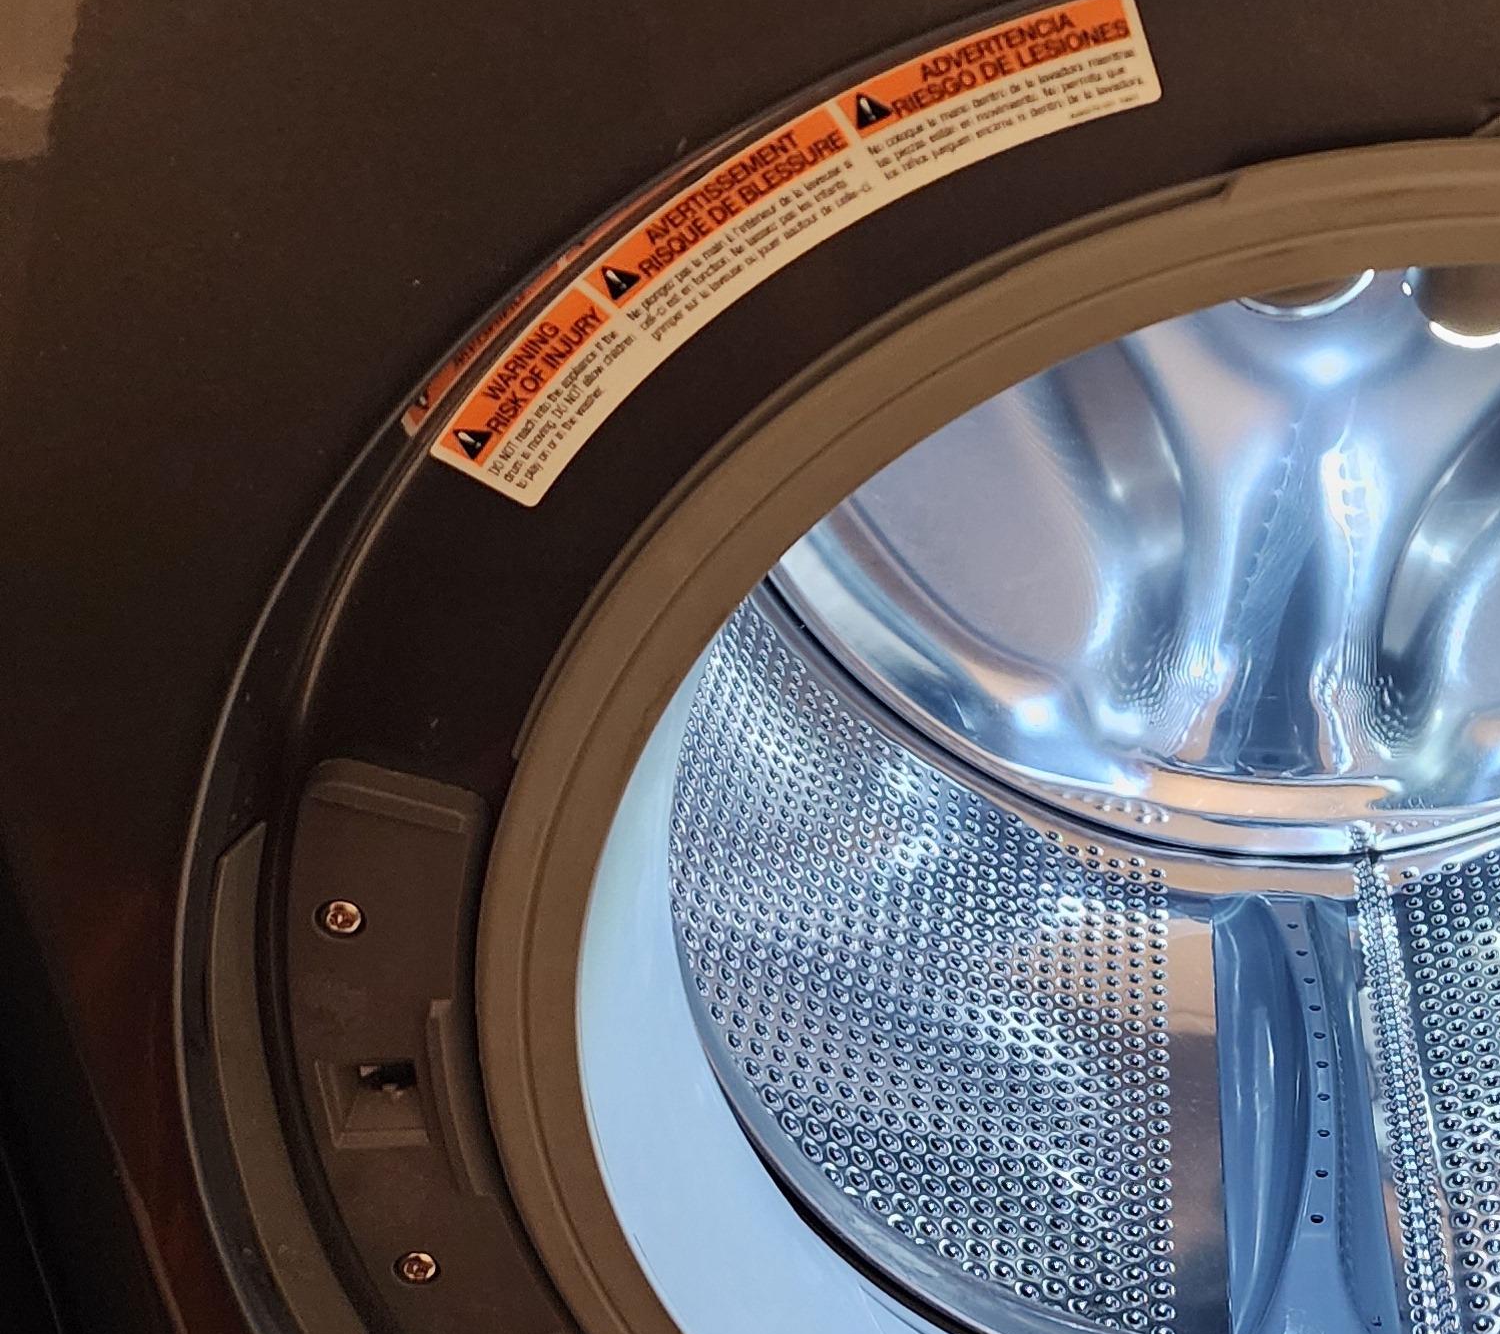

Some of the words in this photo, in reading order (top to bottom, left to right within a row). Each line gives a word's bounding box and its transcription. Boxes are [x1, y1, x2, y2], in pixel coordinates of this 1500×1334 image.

[890, 70, 977, 118] RIESGO
[982, 56, 1013, 81] DE
[1017, 19, 1130, 67] LESIONES
[920, 12, 1076, 82] ADVERTENCIA
[637, 221, 713, 279] RISQUE
[707, 198, 739, 225] DE
[738, 130, 849, 204] BLESSURE
[645, 130, 798, 245] AVERTISSEMENT
[483, 321, 560, 401] WARNING
[486, 393, 528, 435] RISK
[519, 366, 545, 393] OF
[540, 306, 602, 370] INJURY
